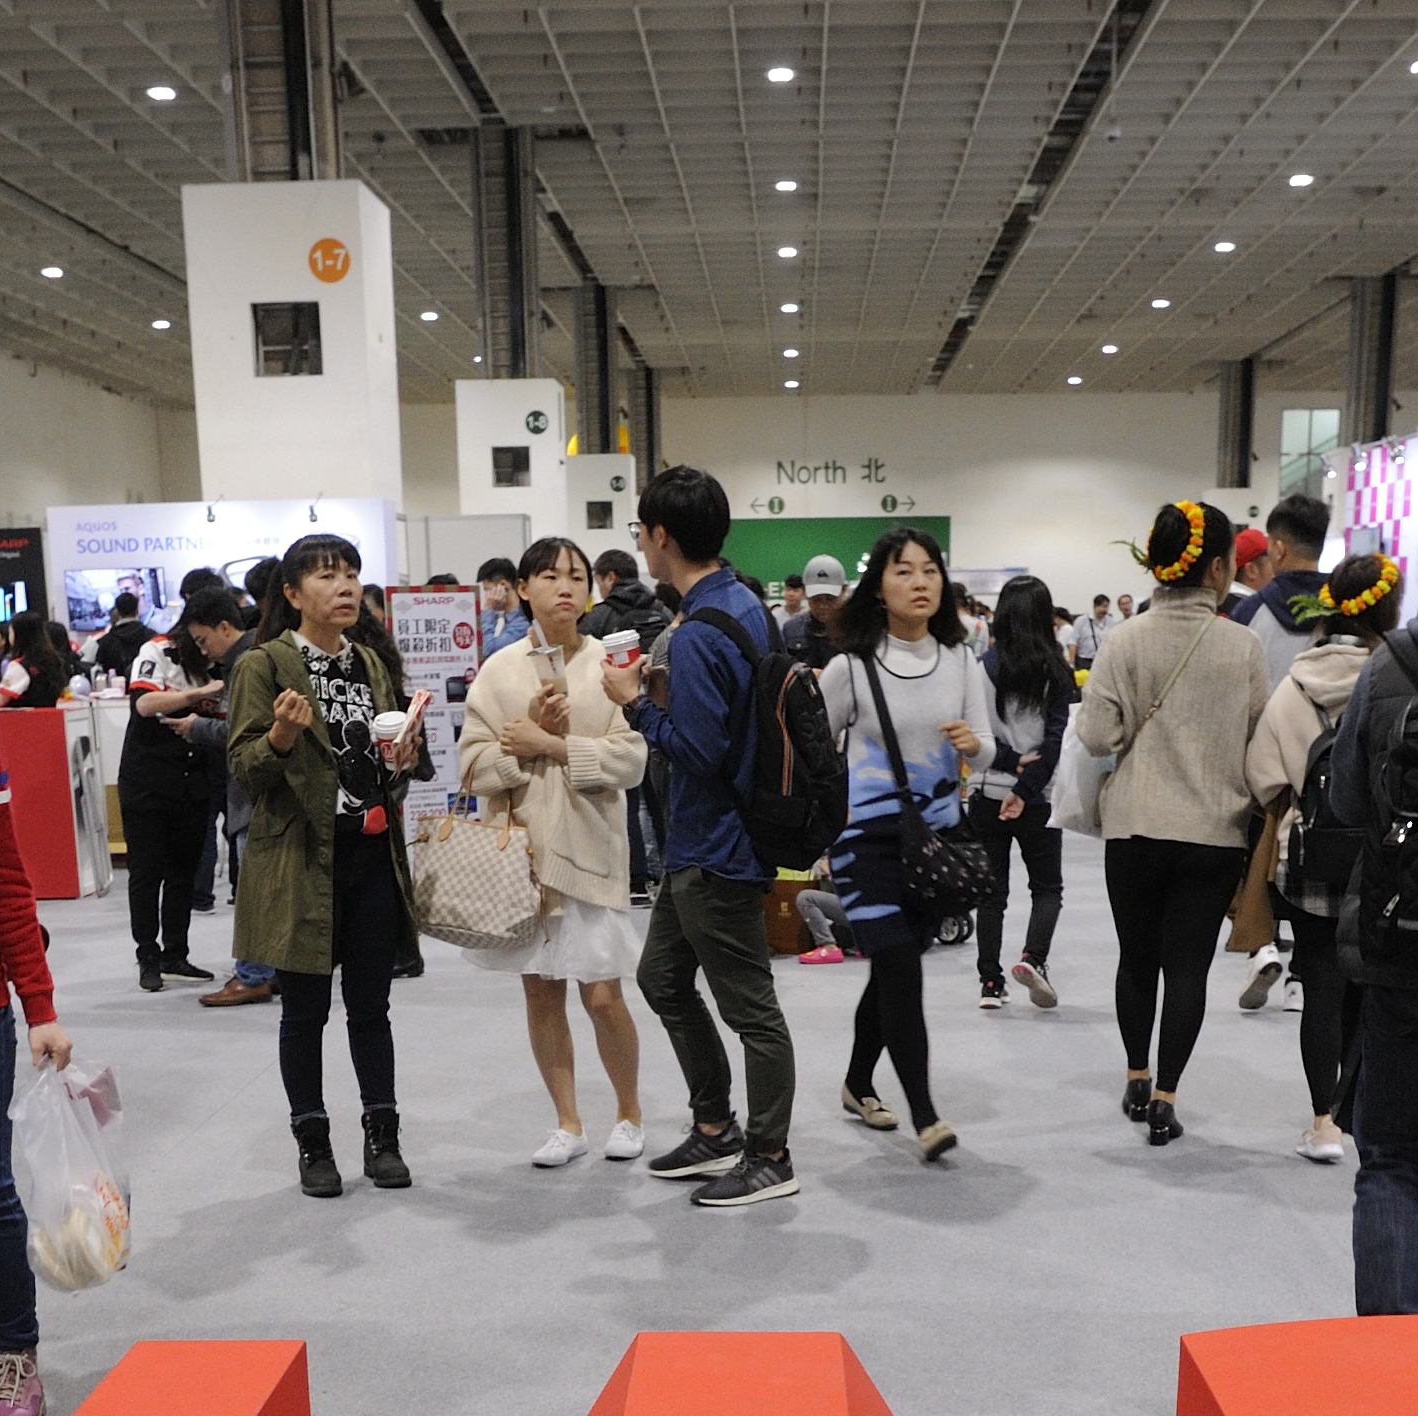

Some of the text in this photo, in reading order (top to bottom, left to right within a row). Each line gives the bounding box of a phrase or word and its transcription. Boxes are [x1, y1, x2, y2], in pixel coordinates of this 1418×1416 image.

[312, 248, 346, 271] 1-7
[776, 457, 886, 485] North 北
[76, 521, 117, 533] AQUOS
[76, 535, 214, 555] SOUND PARTNE
[413, 597, 454, 605] SHARP
